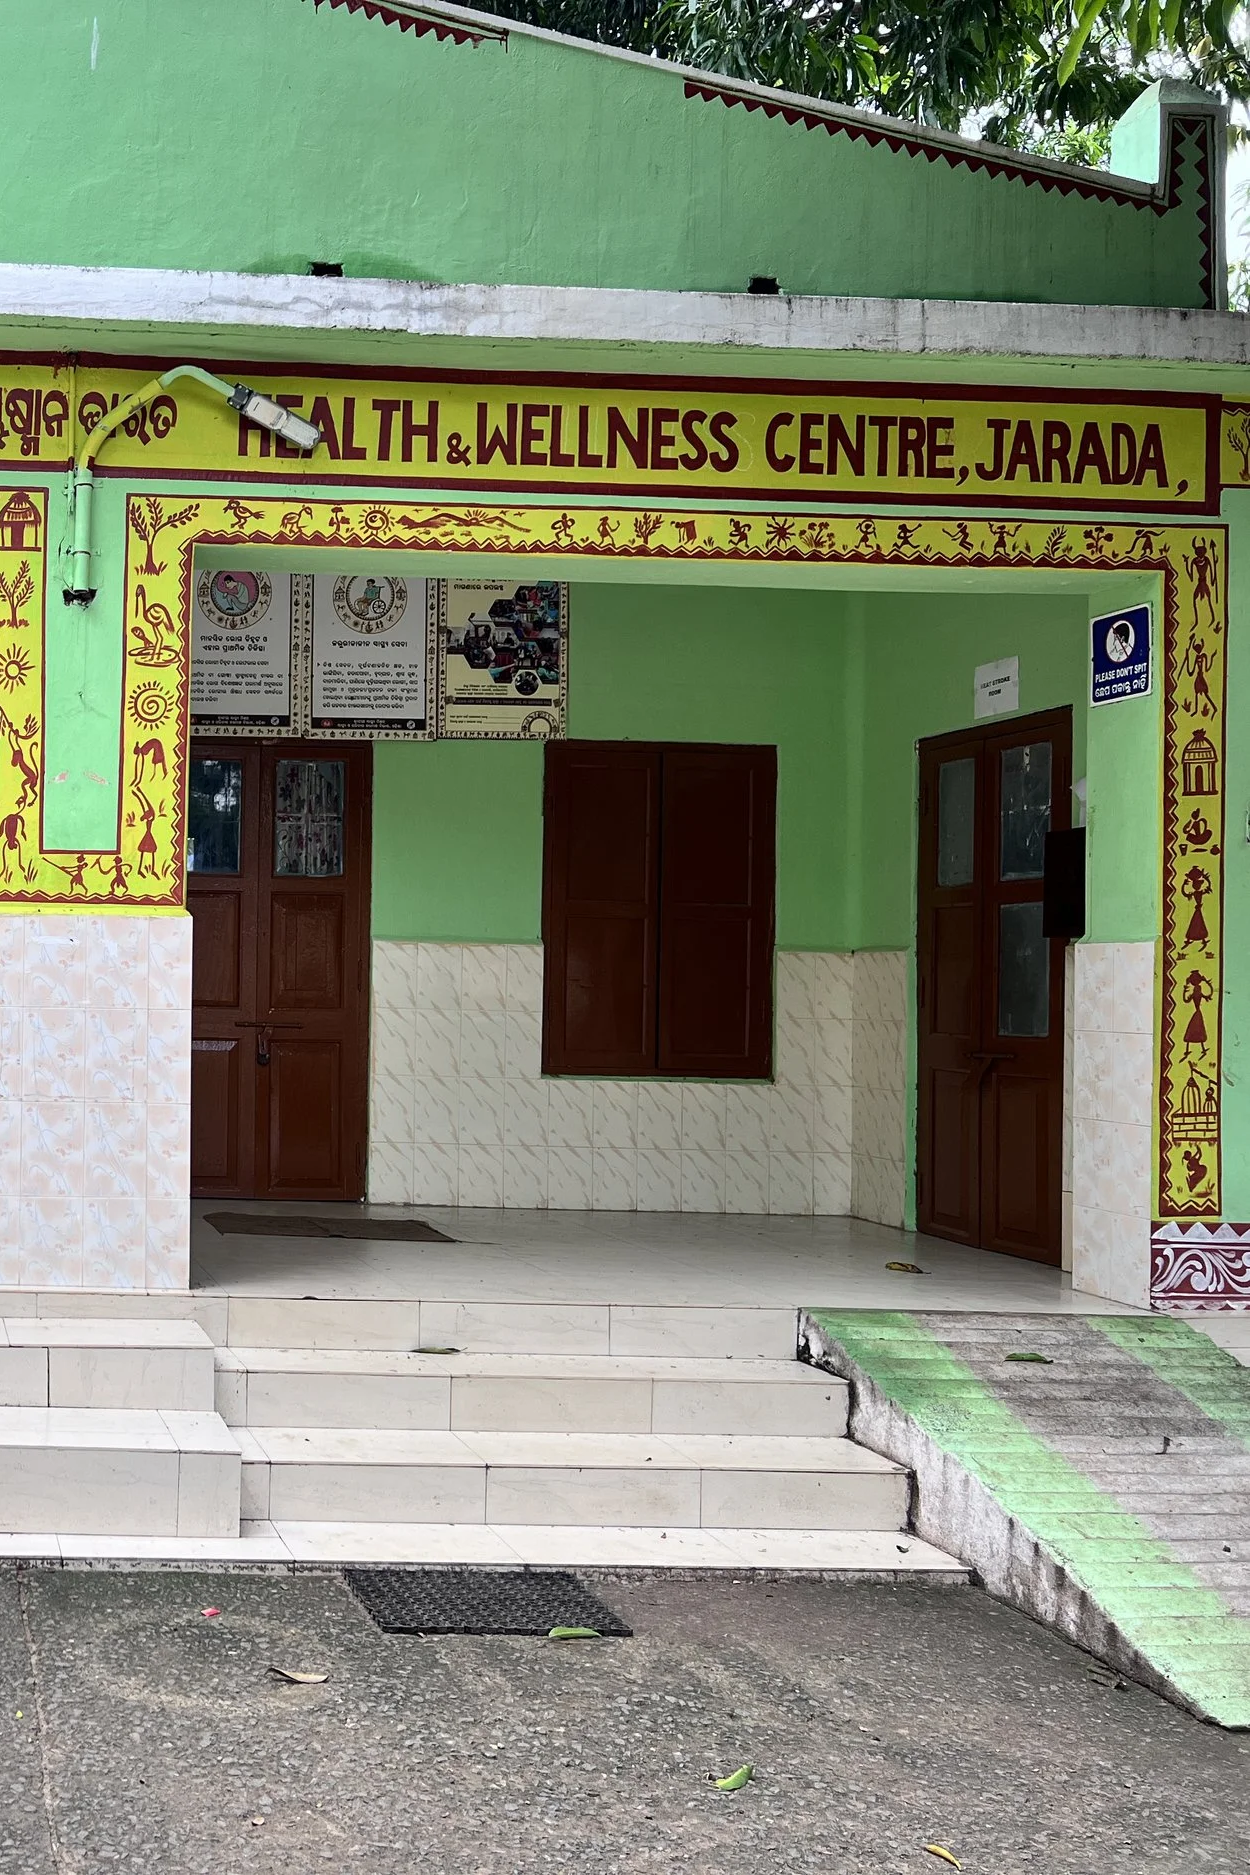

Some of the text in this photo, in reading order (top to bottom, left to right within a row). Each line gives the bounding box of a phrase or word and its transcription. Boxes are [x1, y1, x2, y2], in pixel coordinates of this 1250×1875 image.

[476, 402, 740, 474] WELLNESS
[975, 418, 1190, 497] JARADA,
[1095, 663, 1147, 683] PLEASE DON'T SPIT
